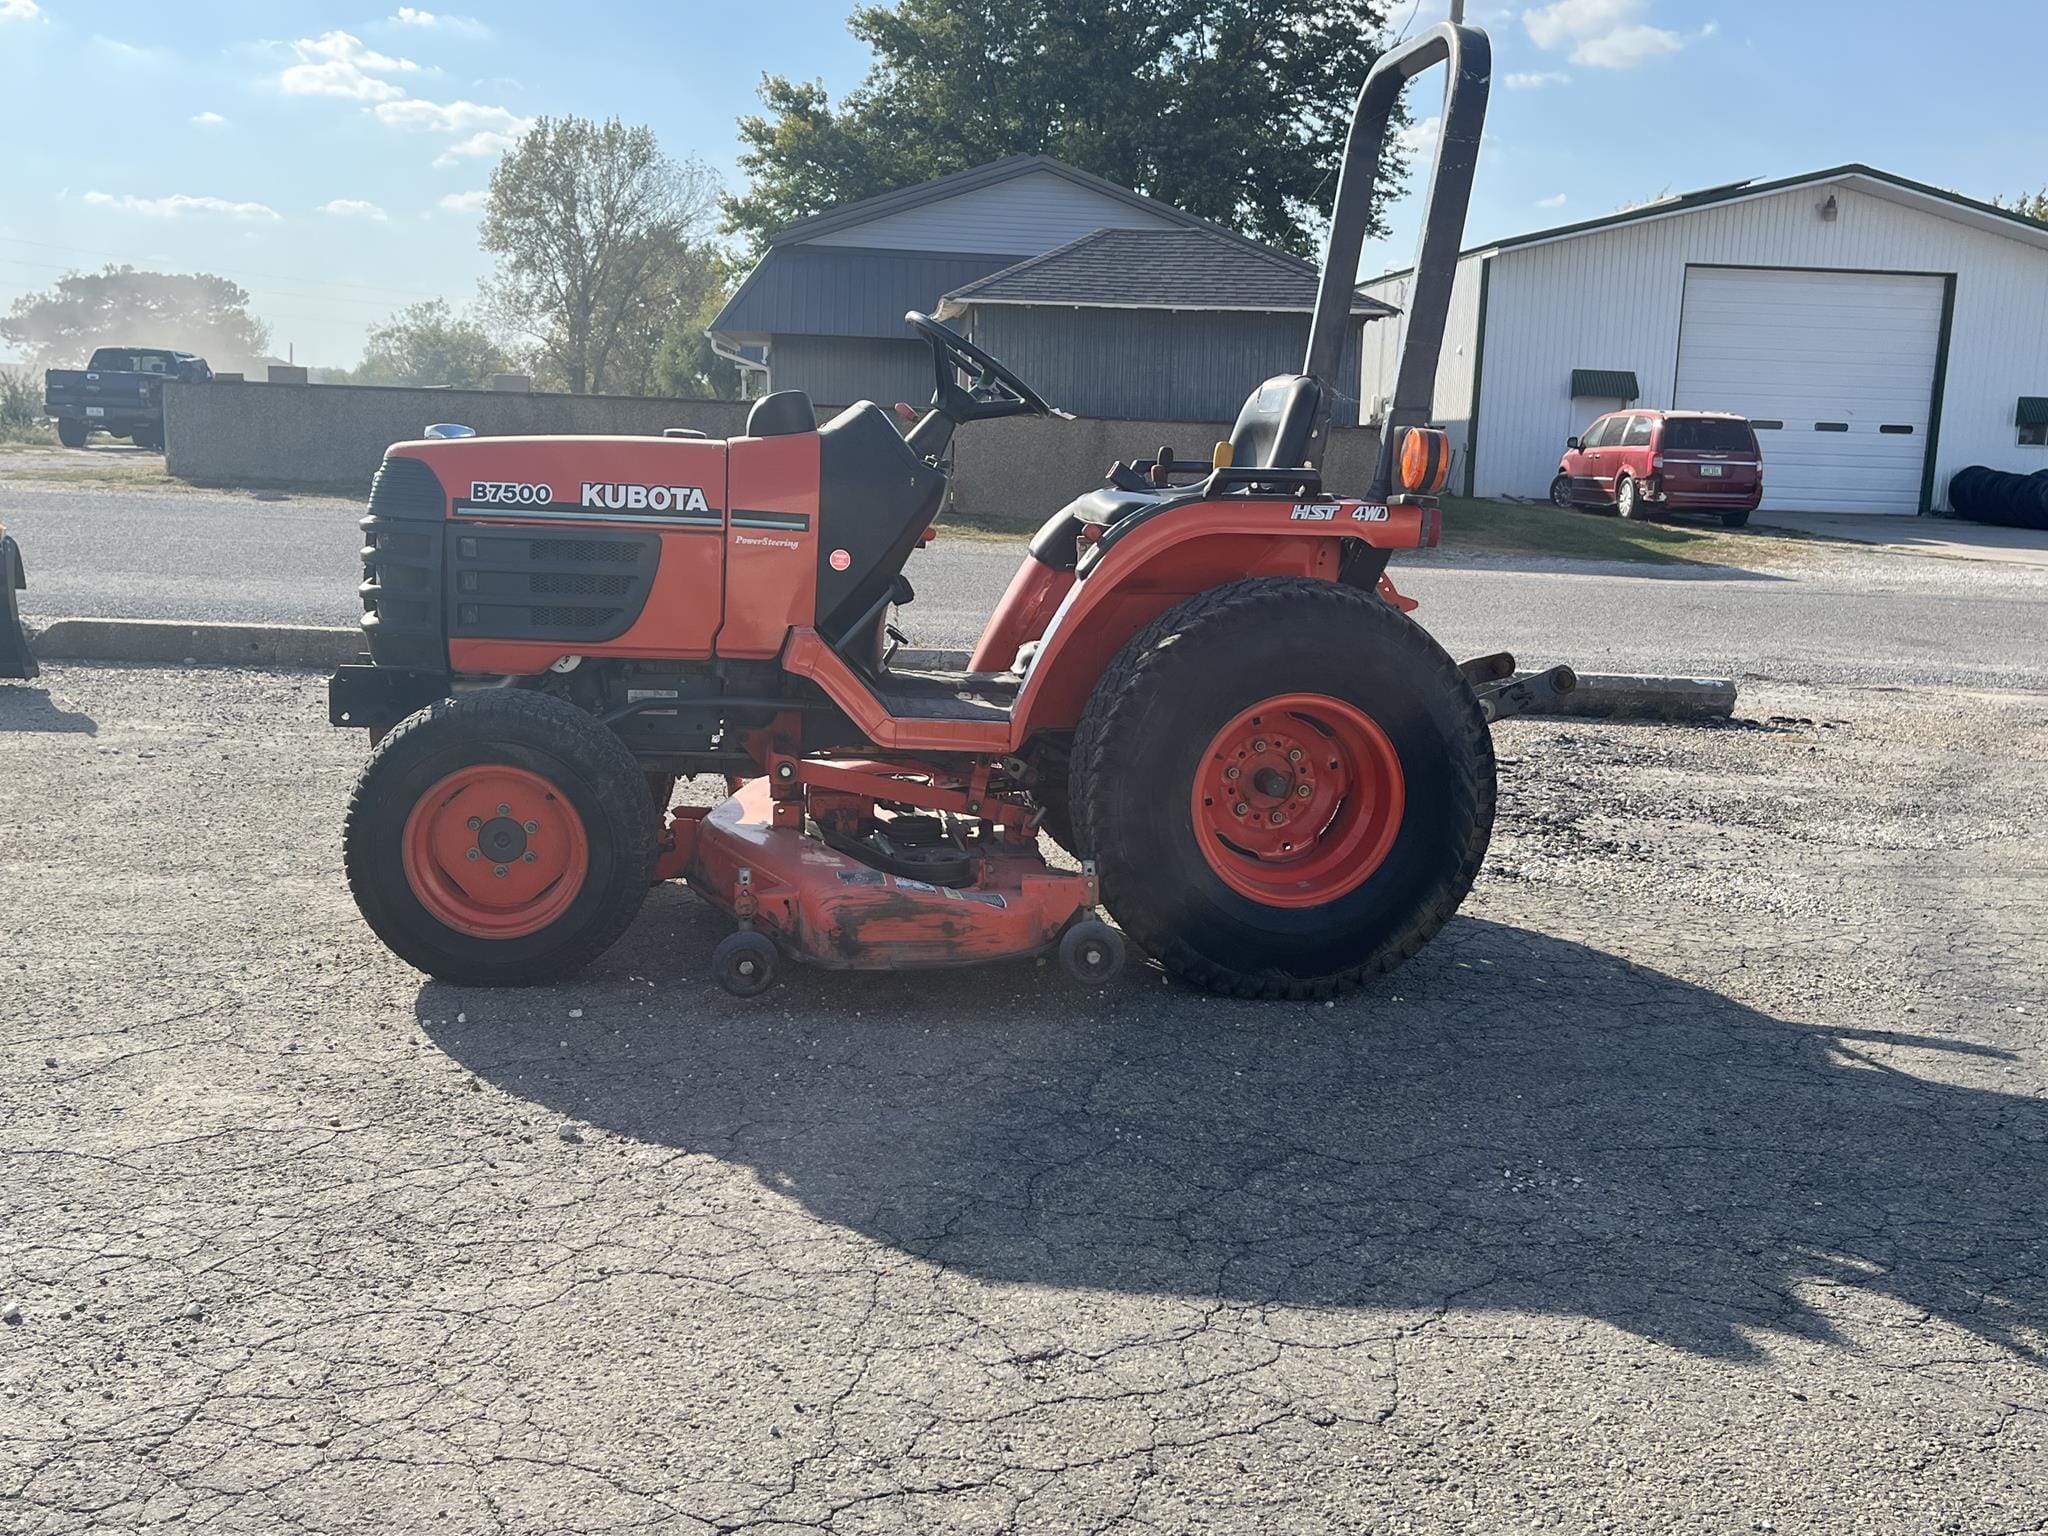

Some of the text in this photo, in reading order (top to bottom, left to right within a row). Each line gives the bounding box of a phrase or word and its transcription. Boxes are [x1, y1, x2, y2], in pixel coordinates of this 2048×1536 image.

[471, 481, 552, 504] B7500
[580, 483, 708, 511] KUBOTA
[1290, 504, 1388, 522] HST 4WD
